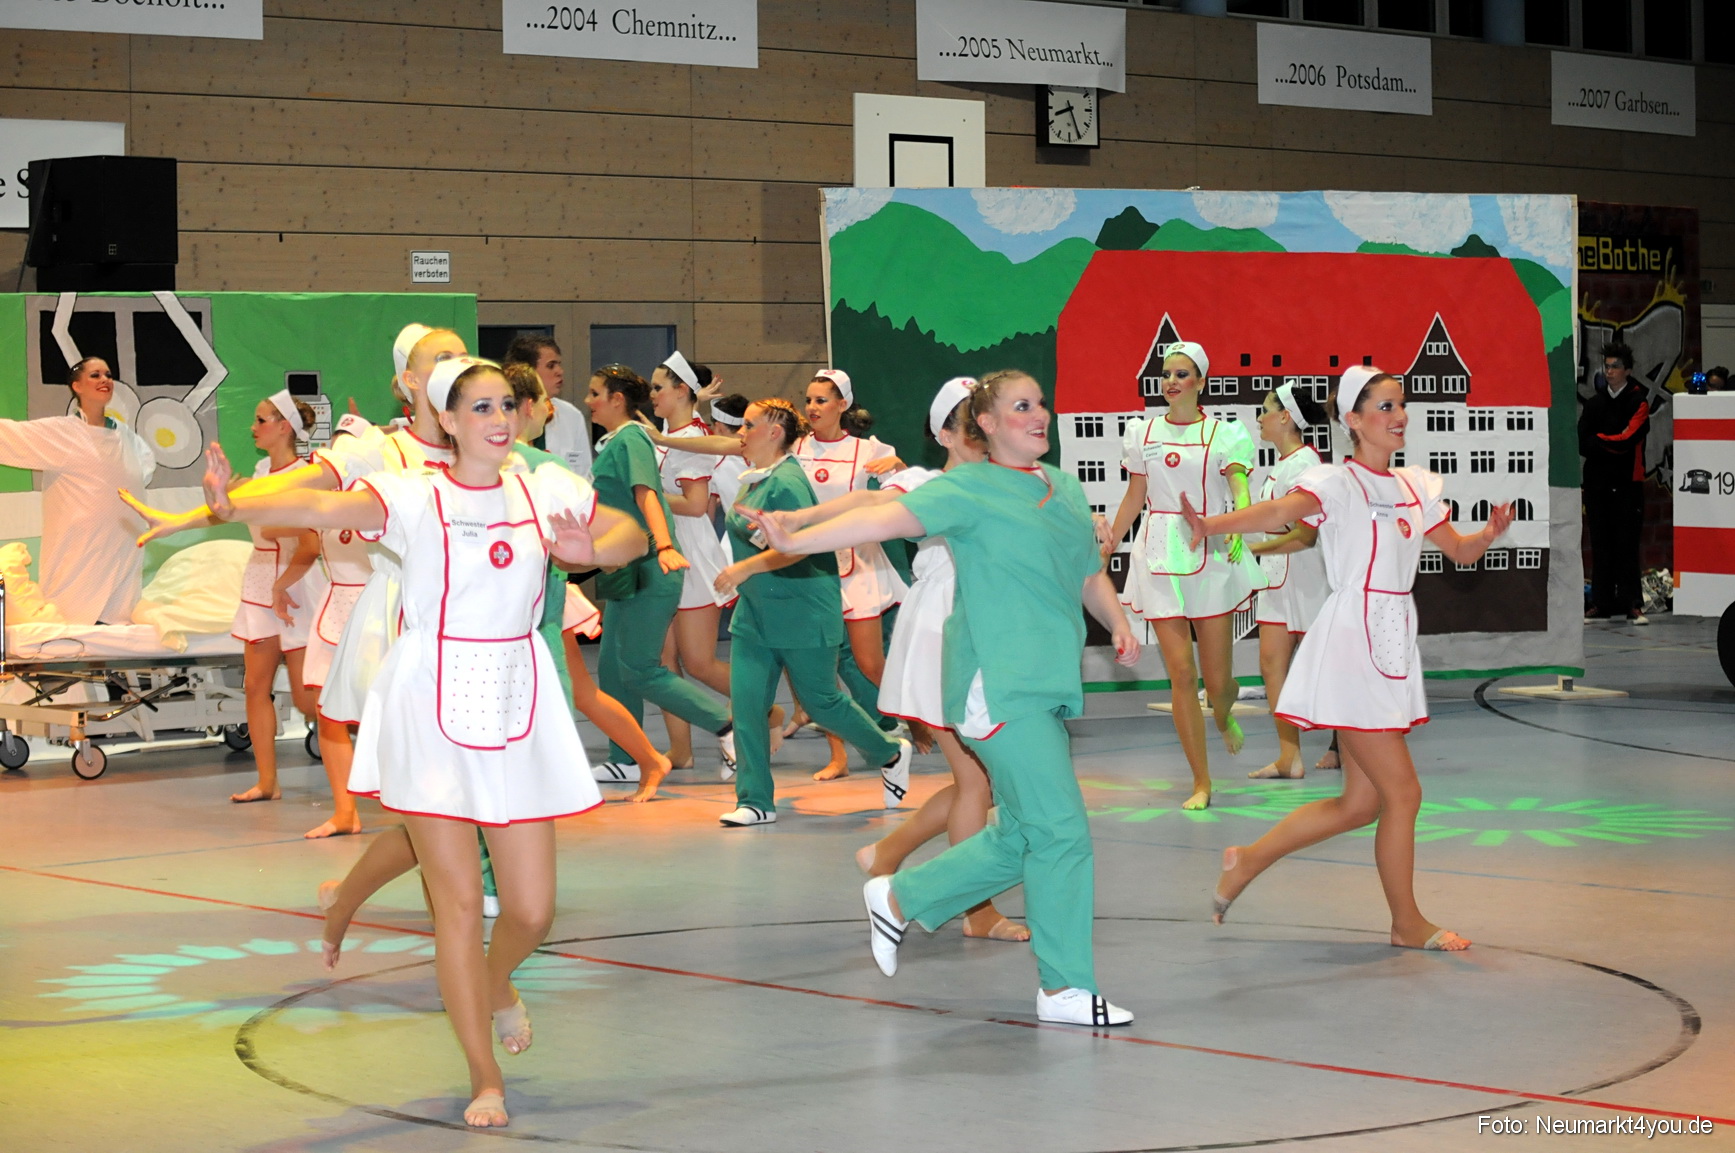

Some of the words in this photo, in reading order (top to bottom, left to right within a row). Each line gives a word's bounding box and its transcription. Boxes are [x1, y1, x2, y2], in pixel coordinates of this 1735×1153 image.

[526, 6, 598, 32] ...2004
[612, 8, 737, 42] Chemnitz...
[939, 36, 1002, 59] ...2005
[1005, 38, 1113, 67] Neumarkt...
[1275, 63, 1326, 86] ...2006
[1336, 65, 1417, 93] Potsdam...
[1568, 88, 1610, 109] ...2007
[1615, 90, 1680, 116] Garbsen...
[414, 256, 447, 265] Rauchen
[414, 269, 448, 278] verboten
[451, 519, 486, 529] Schwester
[462, 530, 478, 538] Julia
